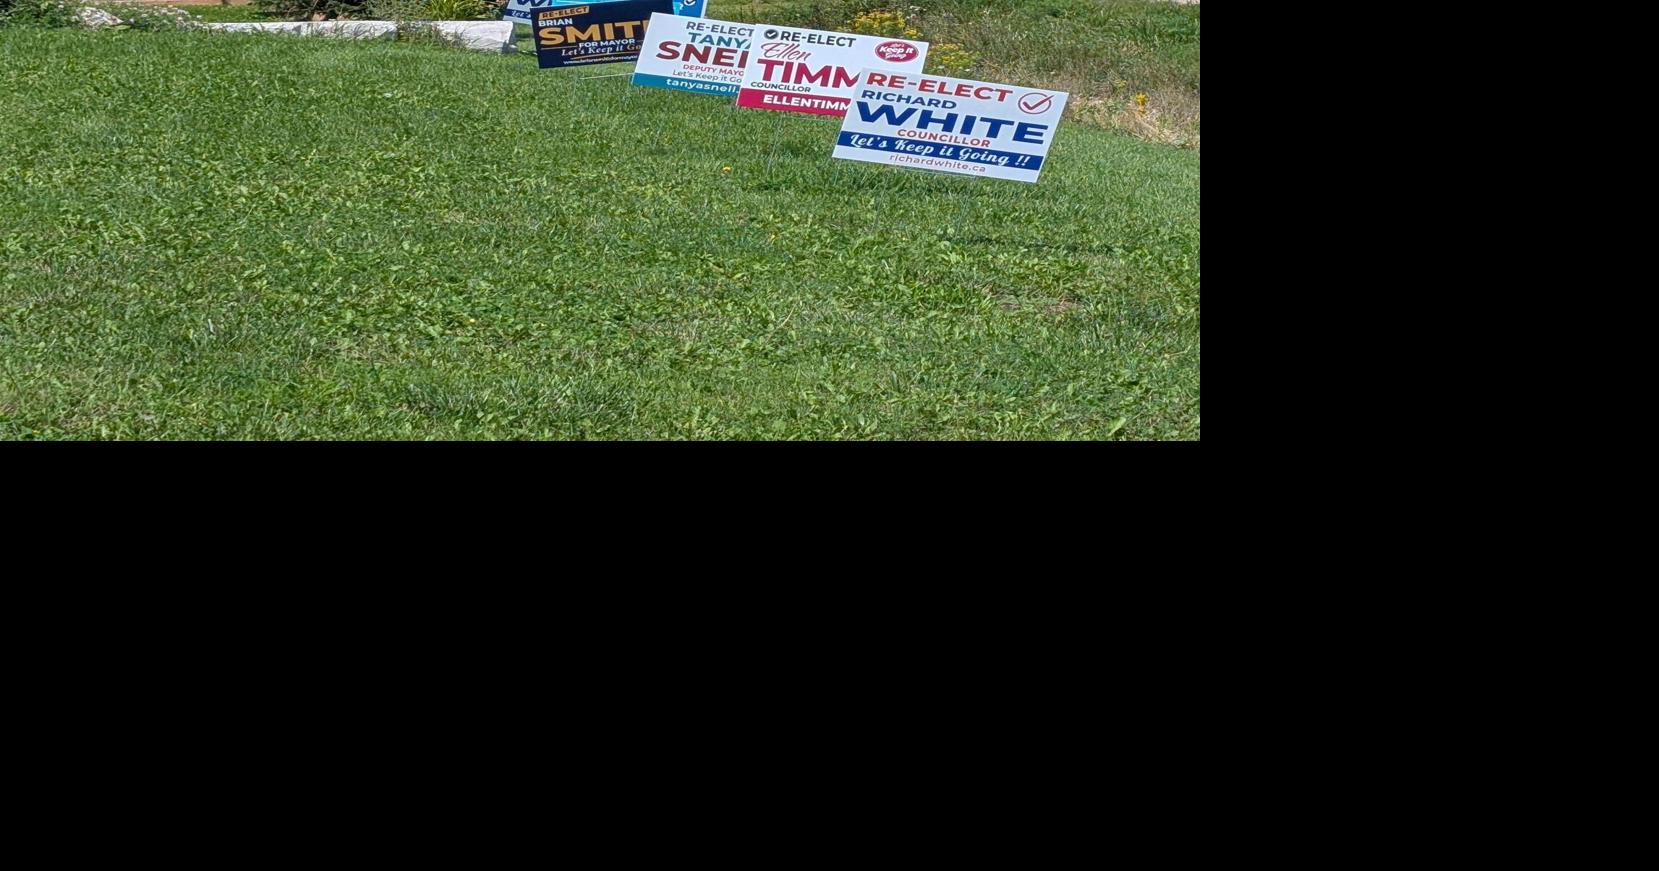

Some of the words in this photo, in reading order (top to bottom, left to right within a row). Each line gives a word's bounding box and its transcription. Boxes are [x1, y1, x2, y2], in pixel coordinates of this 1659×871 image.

[542, 6, 588, 18] RE-ELECT
[539, 18, 573, 26] BRIAN
[686, 21, 754, 37] RE-ELECT
[600, 39, 635, 47] MAYOR
[780, 31, 857, 48] RE-ELECT
[588, 45, 612, 54] Keep
[761, 42, 812, 61] Ellen
[880, 45, 904, 55] Keep
[673, 69, 693, 78] Let's
[695, 73, 718, 82] Keep
[683, 64, 717, 74] DEPUTY
[751, 81, 811, 93] COUNCILLOR
[867, 72, 1013, 102] RE-ELECT
[861, 90, 957, 109] RICHARD
[856, 101, 1048, 144] WHITE
[897, 129, 991, 148] COUNCILLOR
[850, 134, 887, 149] Let's
[894, 139, 934, 157] Keep
[940, 146, 954, 156] it
[958, 148, 1010, 167] Going
[1013, 156, 1032, 167] !!
[889, 153, 987, 173] richardwhite.ca
